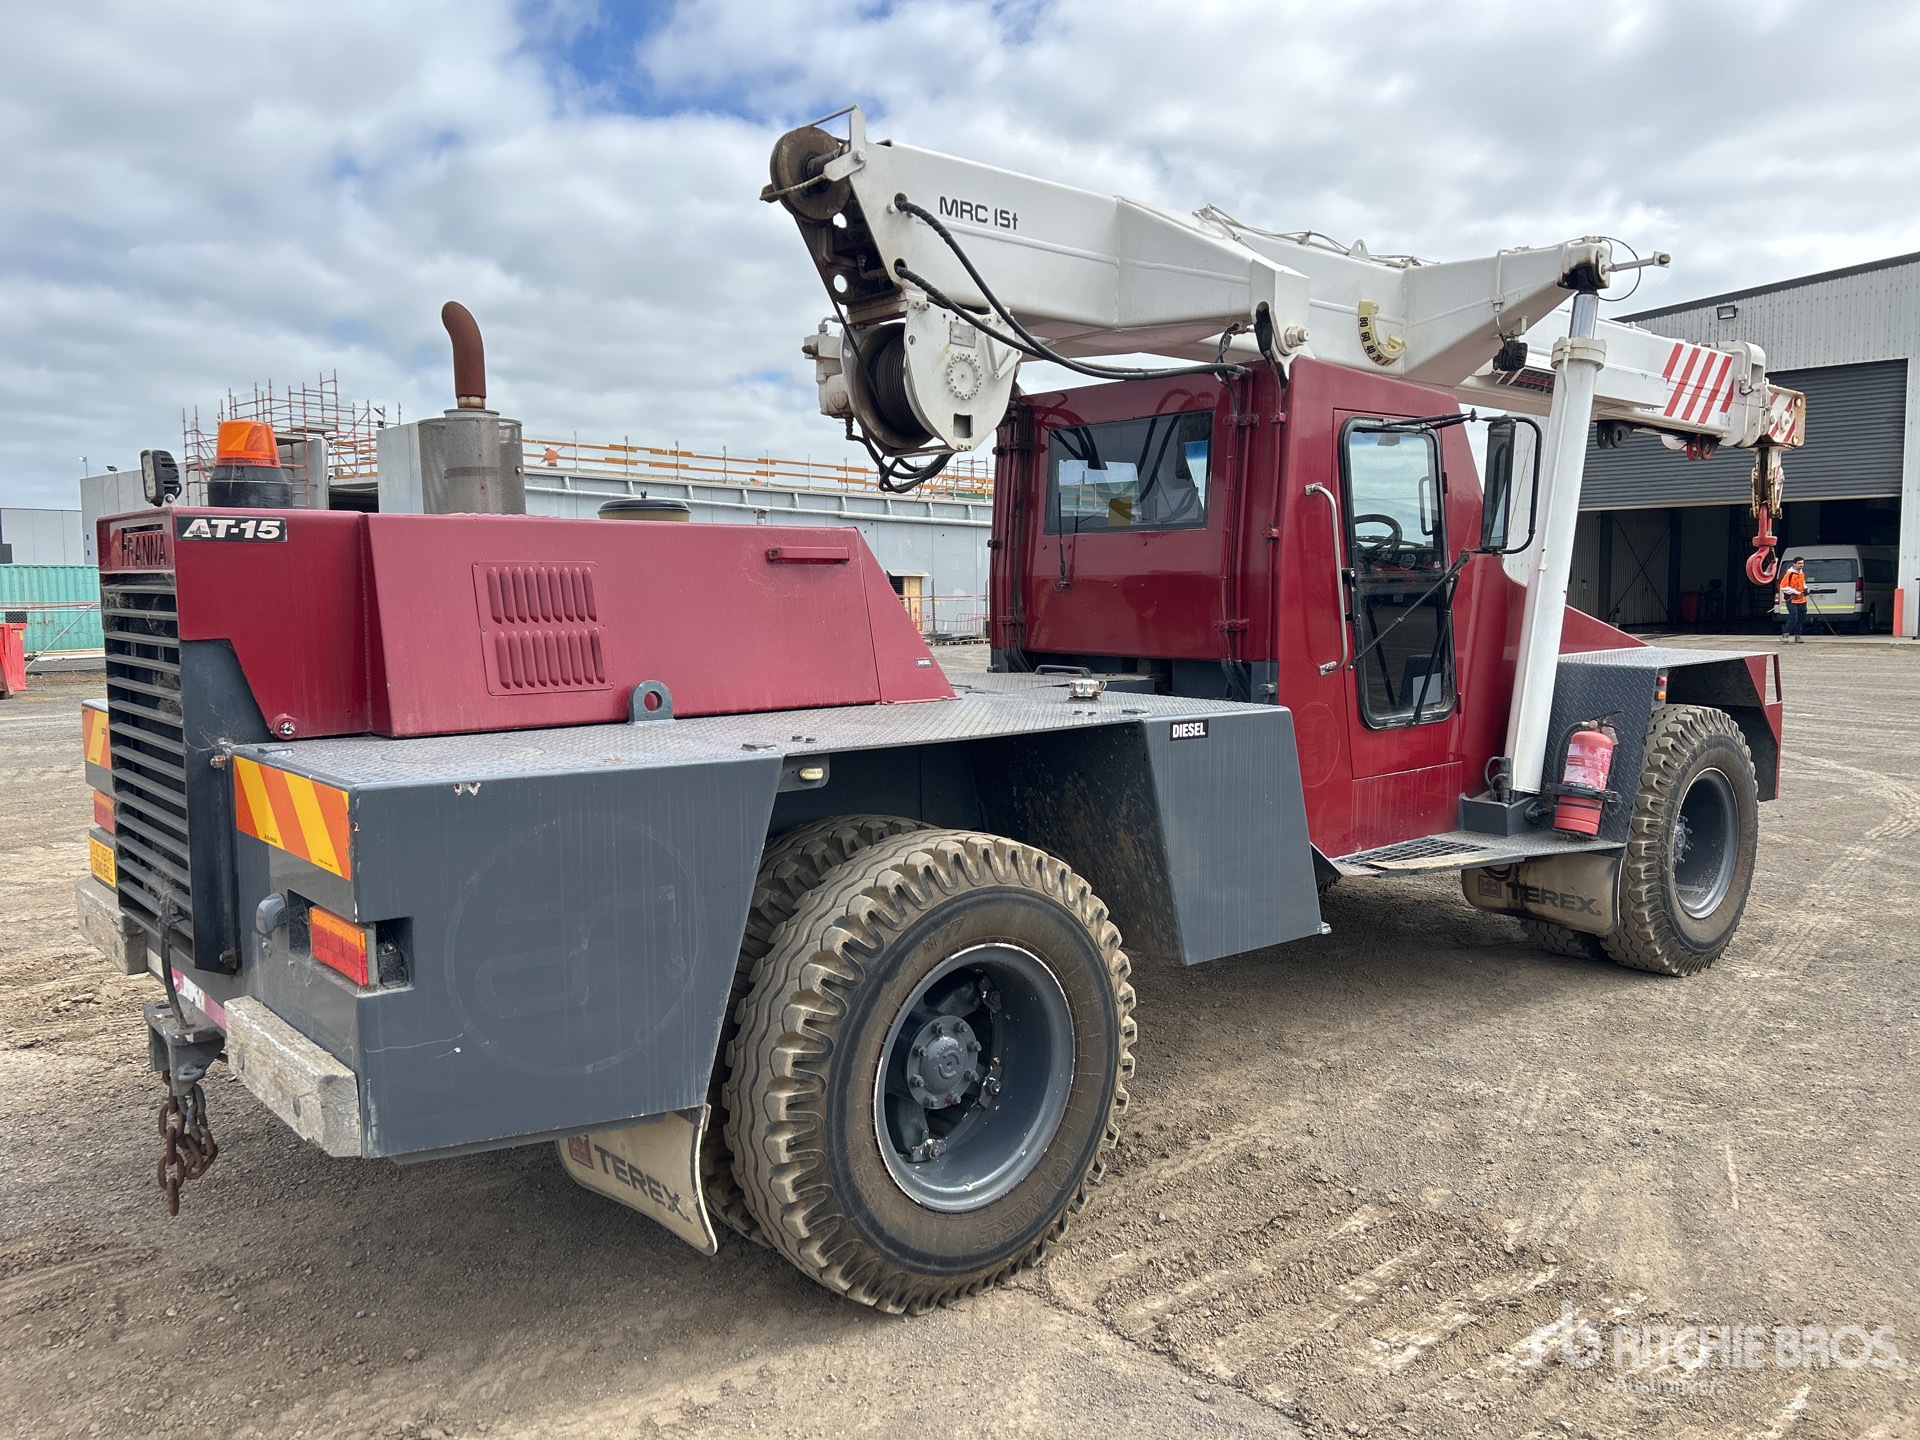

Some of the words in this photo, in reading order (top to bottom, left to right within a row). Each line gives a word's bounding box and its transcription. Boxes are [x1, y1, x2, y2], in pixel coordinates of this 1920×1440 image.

[939, 195, 988, 224] MRC
[1359, 316, 1369, 328] 80
[1361, 331, 1372, 343] 60
[1366, 344, 1377, 354] 40
[182, 518, 281, 539] AT-15
[121, 527, 167, 567] FRANNA
[1172, 722, 1206, 738] DIESEL
[1505, 881, 1600, 915] TEREX
[594, 1143, 690, 1223] TEREX
